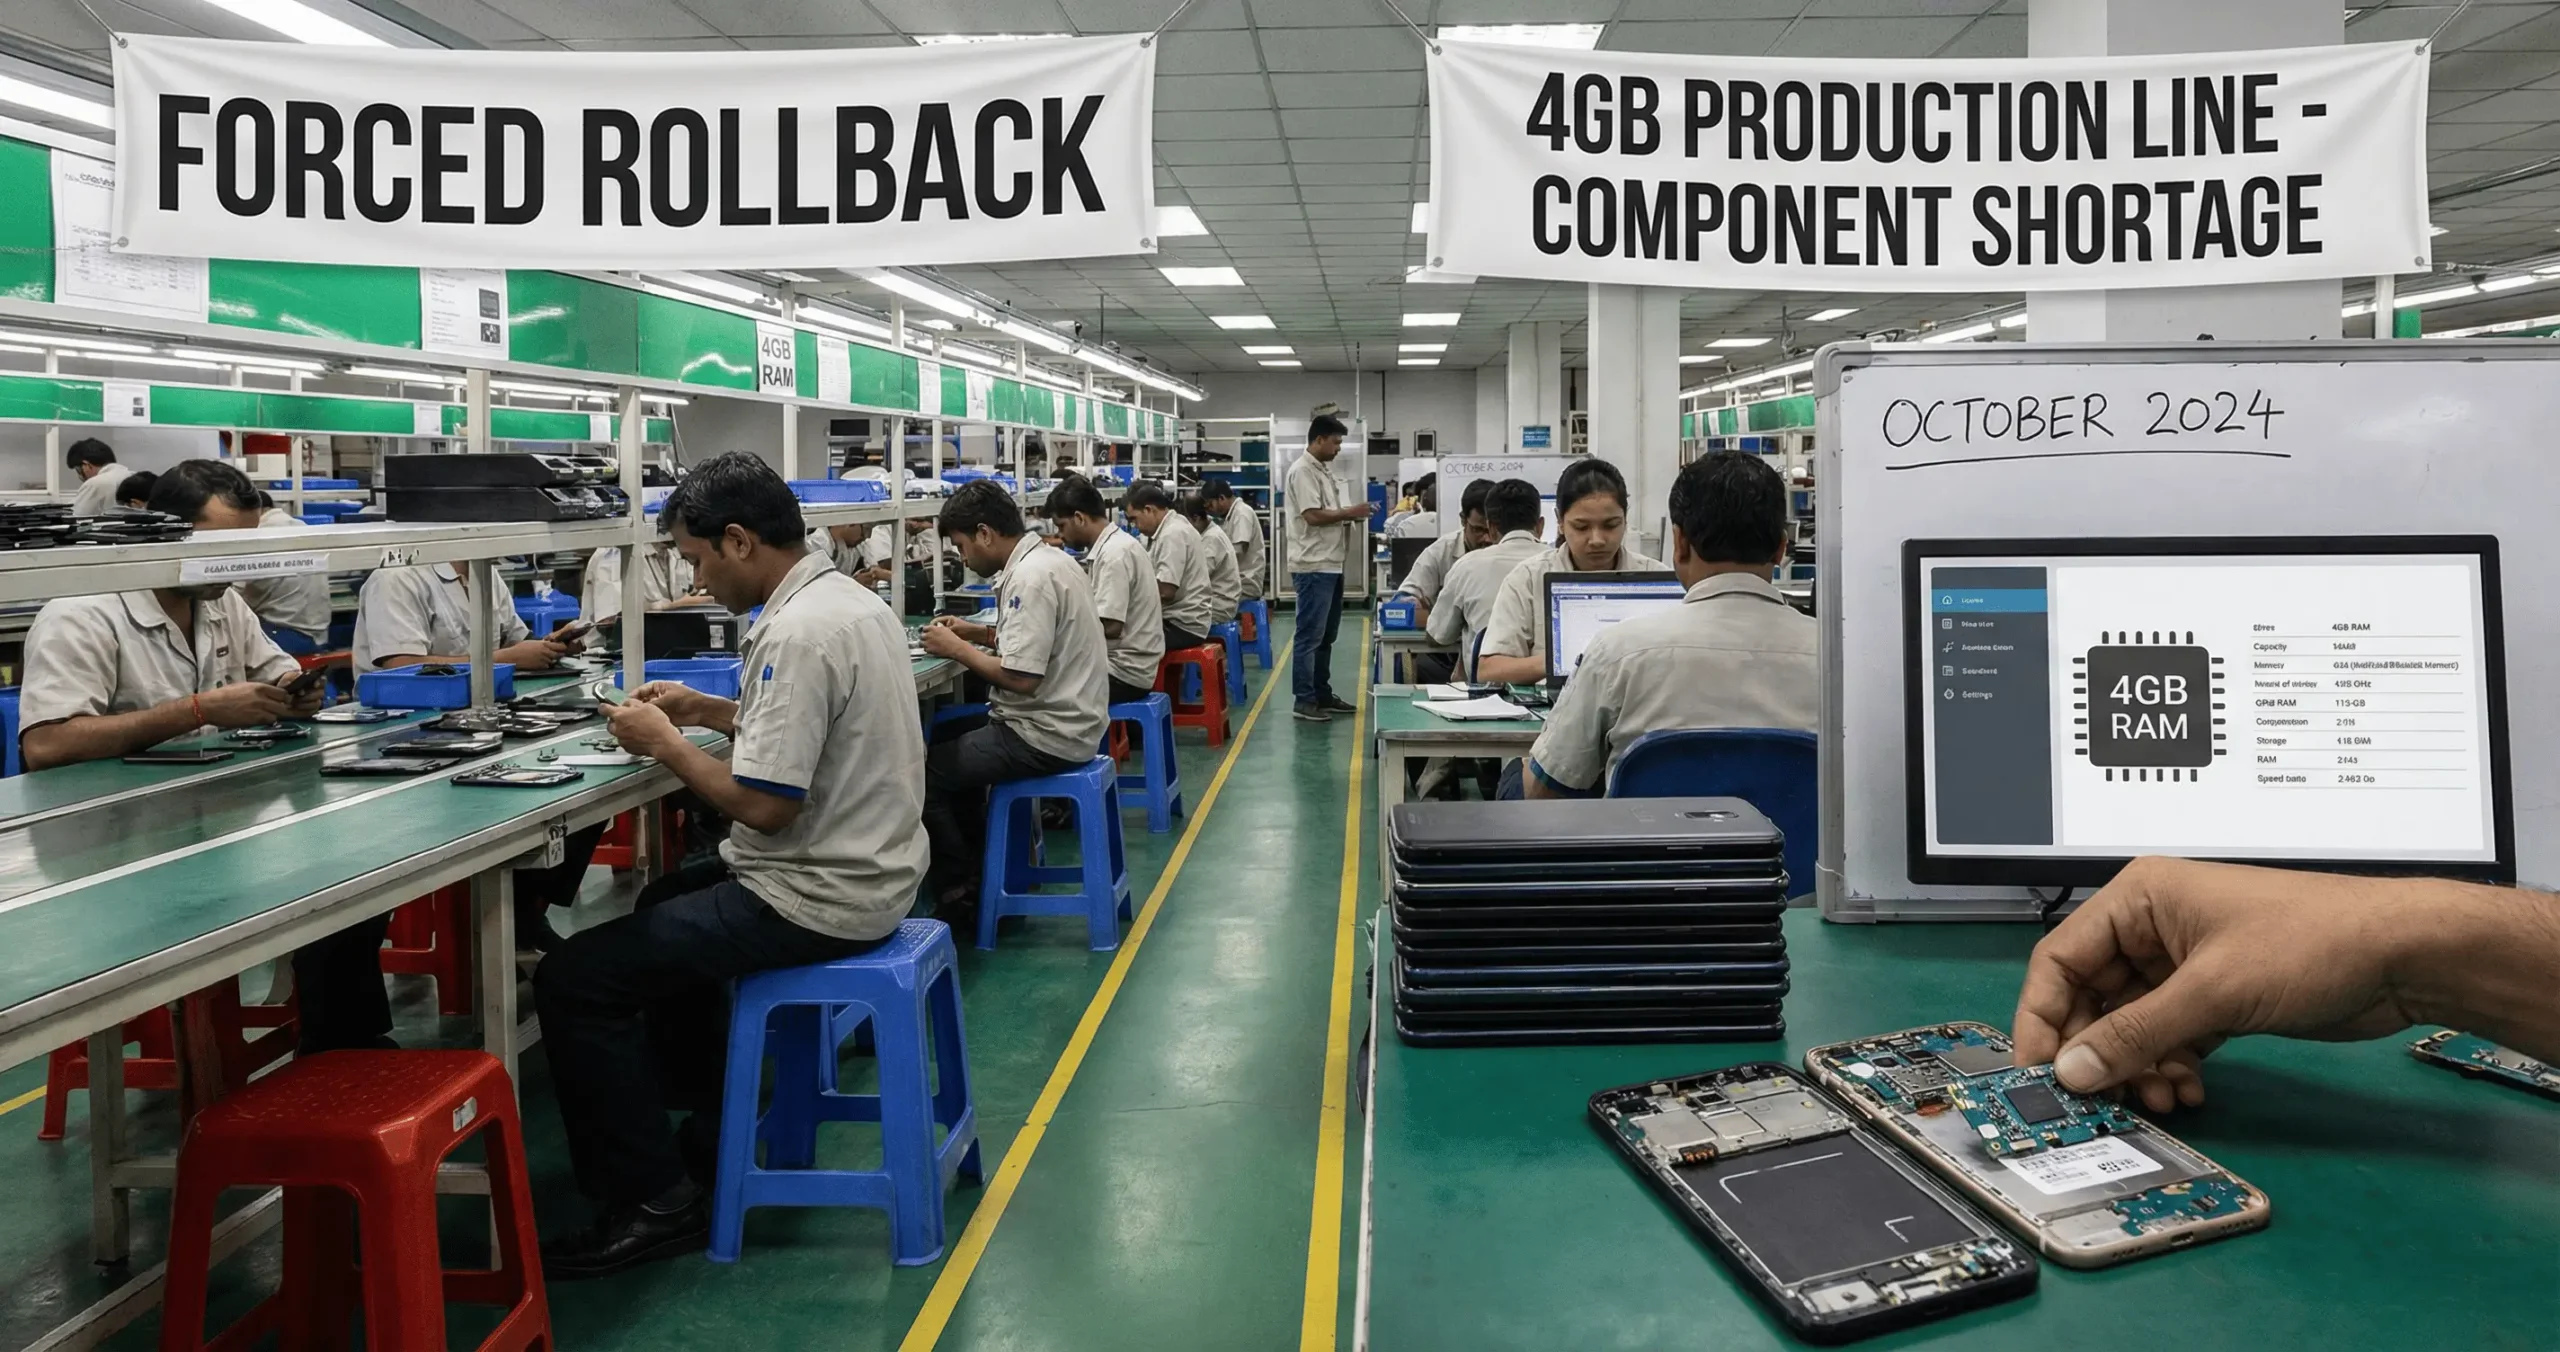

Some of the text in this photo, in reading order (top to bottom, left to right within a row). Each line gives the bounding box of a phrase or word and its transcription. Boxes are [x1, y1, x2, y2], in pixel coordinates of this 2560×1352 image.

[1526, 72, 2328, 163] 4GB PRODUCTION LINE -
[159, 93, 1107, 229] FORCED ROLLBACK
[1532, 173, 2324, 267] COMPONENT SHORTAGE
[762, 336, 791, 360] 4GB
[762, 364, 794, 388] RAM
[1882, 389, 2286, 448] OCTOBER 2024
[1445, 462, 1525, 475] OCTOBER 2024
[2351, 623, 2371, 631] RAM
[2109, 674, 2188, 706] 4GB
[2277, 698, 2297, 707] RAM
[2111, 712, 2188, 740] RAM
[2256, 736, 2287, 746] Storage
[2257, 755, 2277, 763] RAM
[2257, 774, 2284, 784] Speed
